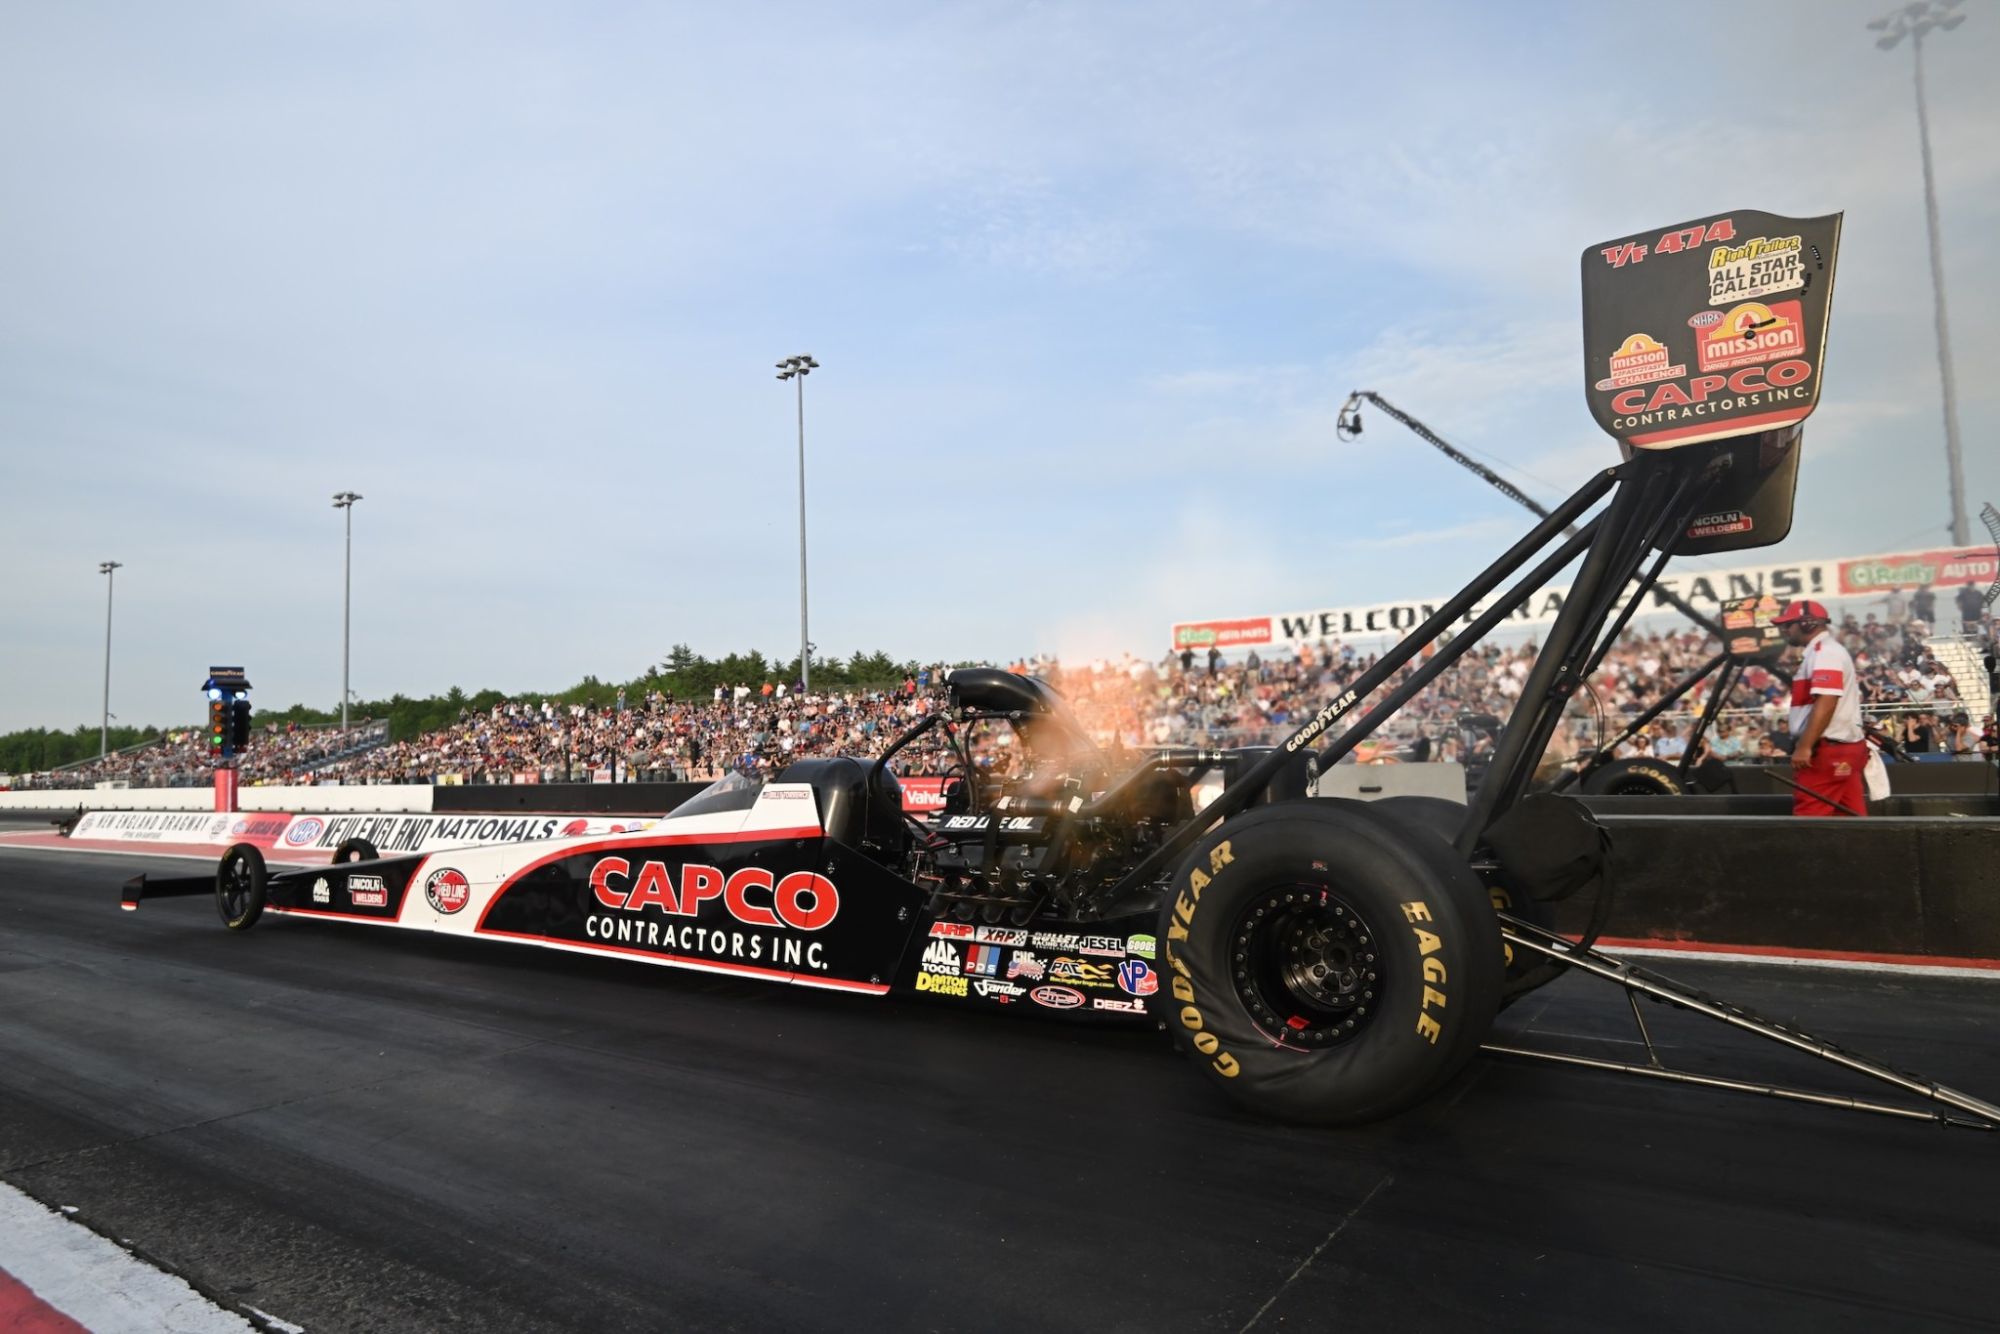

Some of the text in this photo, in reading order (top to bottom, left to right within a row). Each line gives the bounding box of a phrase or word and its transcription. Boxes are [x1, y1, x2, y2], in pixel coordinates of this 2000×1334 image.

[1601, 218, 1736, 269] T/F 474
[1712, 266, 1745, 283] ALL
[1750, 255, 1798, 276] STAR
[1712, 267, 1798, 296] CALLOUT
[1692, 314, 1720, 326] NHRA
[1618, 367, 1682, 386] CHALLENGE
[1610, 359, 1812, 415] CAPCO
[1612, 386, 1810, 430] CONTRACTORS INC.
[1694, 522, 1744, 536] WELDERS
[1942, 561, 1991, 578] AUTO
[1286, 690, 1358, 752] GOODYEAR
[287, 820, 321, 843] NHRA
[429, 817, 559, 842] NATIONALS
[944, 815, 1034, 830] RED LIE OIL
[350, 877, 381, 892] LINCOLN
[451, 883, 468, 899] LINE
[590, 856, 839, 931] CAPCO
[355, 892, 383, 904] WELDERS
[930, 922, 974, 937] ARP
[983, 928, 1017, 943] XRP
[586, 915, 829, 970] CONTRACTORS INC.
[1080, 935, 1126, 951] JESEL
[921, 939, 961, 967] MAC
[1013, 950, 1035, 962] CNC
[1165, 840, 1241, 1078] GOODYEAR
[921, 962, 961, 976] TOOLS
[966, 961, 997, 974] PDS
[1050, 961, 1081, 976] PAC
[1118, 959, 1148, 994] VP
[1400, 900, 1447, 1045] EAGLE
